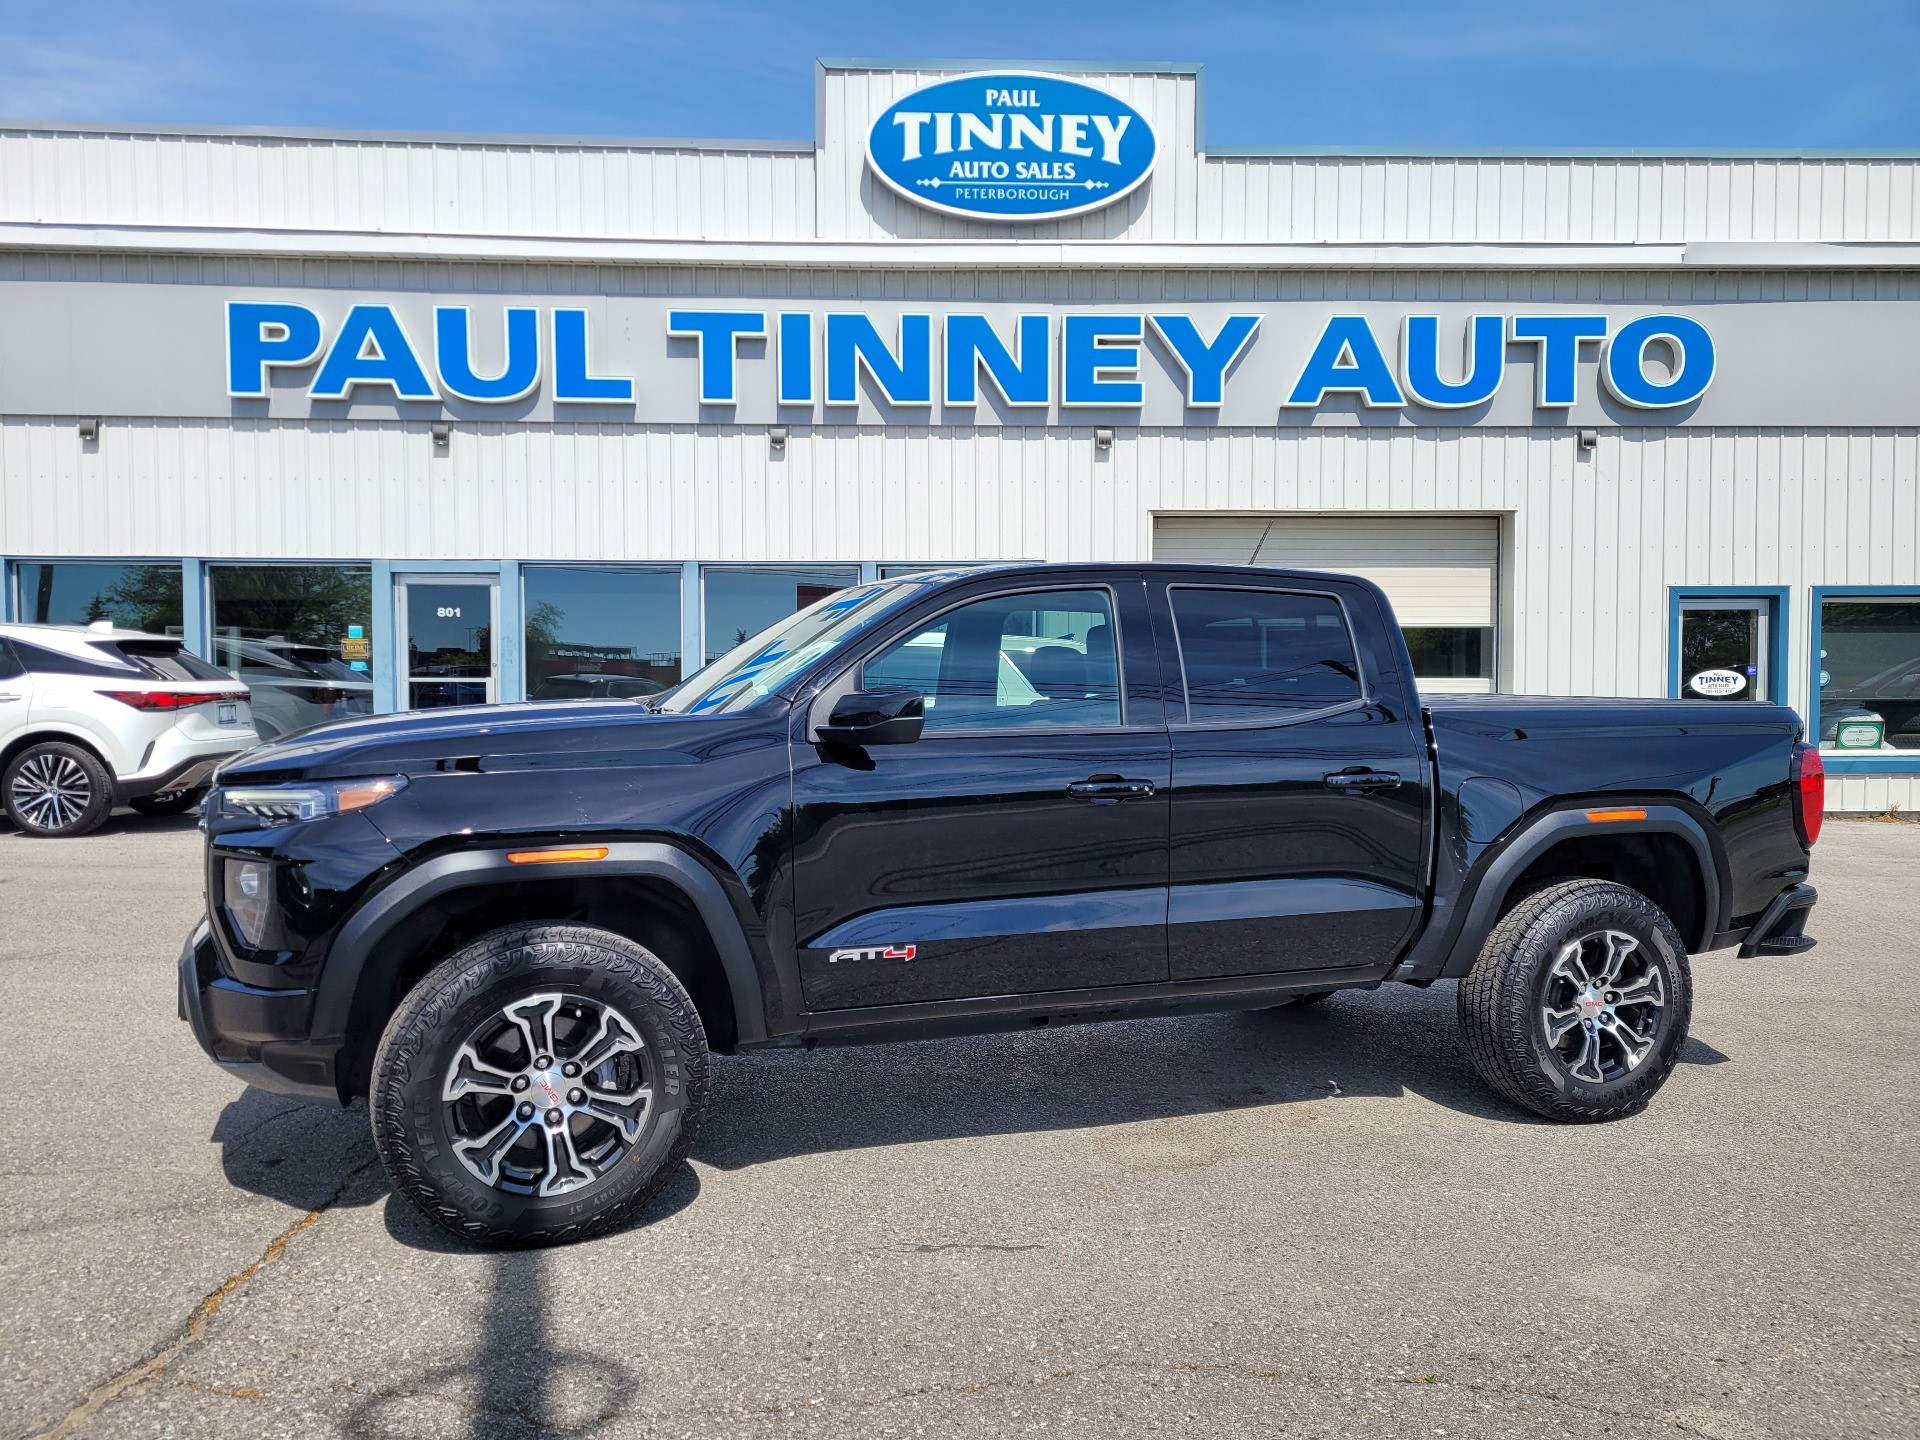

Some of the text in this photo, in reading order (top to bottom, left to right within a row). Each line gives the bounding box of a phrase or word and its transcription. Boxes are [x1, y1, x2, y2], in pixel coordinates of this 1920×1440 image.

[986, 89, 1040, 107] PAUL
[892, 112, 1132, 165] TINNEY
[950, 161, 1076, 180] AUTO SALES
[955, 188, 1070, 200] PETERBOROUGH
[225, 300, 1717, 410] PAUL TINNEY AUTO
[437, 607, 461, 617] 801
[1698, 676, 1739, 685] TINNEY
[829, 944, 916, 963] AT4
[538, 1078, 559, 1103] GMC
